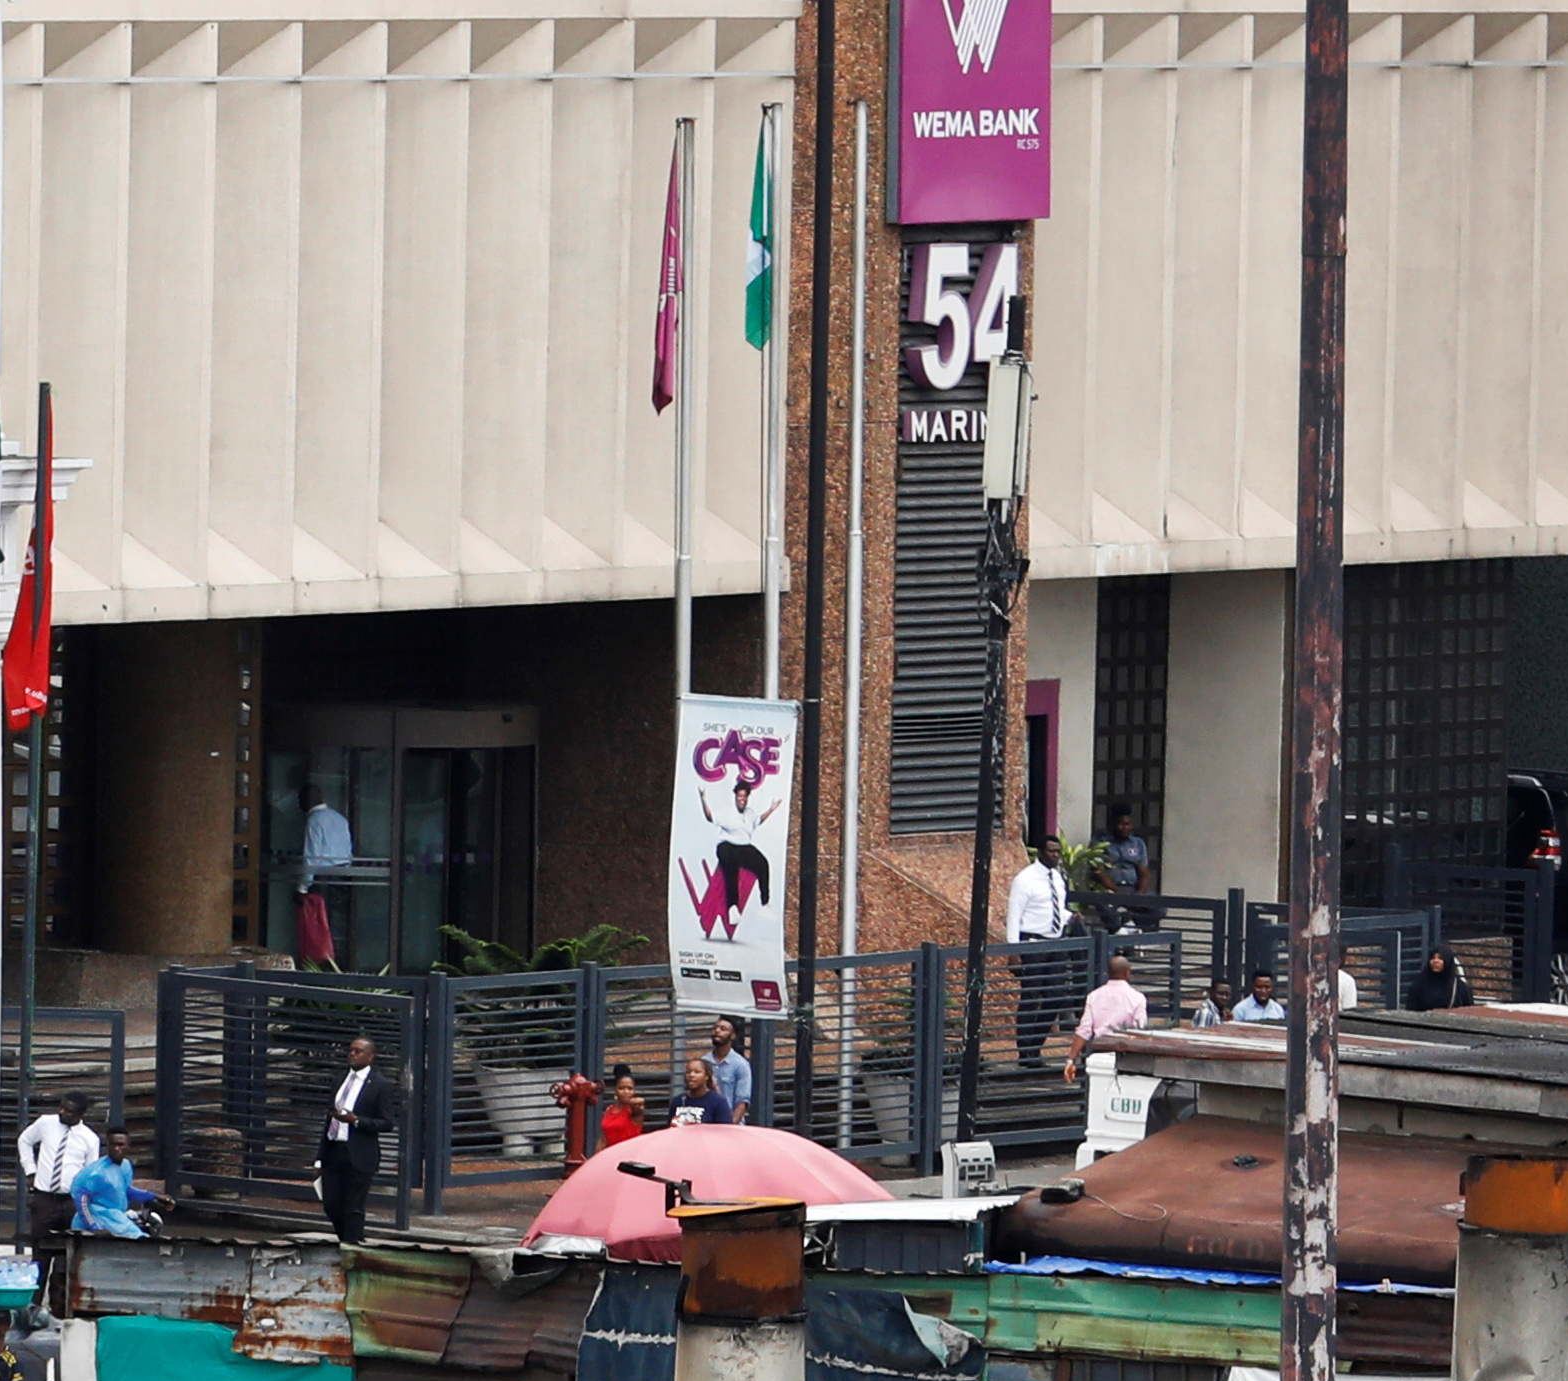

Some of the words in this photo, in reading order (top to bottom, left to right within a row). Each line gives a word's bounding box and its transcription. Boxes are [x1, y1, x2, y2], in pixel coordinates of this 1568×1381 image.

[913, 110, 976, 138] WEMA
[979, 108, 1039, 136] BANK
[1016, 139, 1026, 150] RC
[1027, 138, 1039, 149] 575
[918, 242, 1020, 390] 54
[702, 722, 726, 733] SHE'S
[741, 724, 755, 735] ON
[756, 725, 774, 736] OUR
[693, 728, 782, 790] CASE
